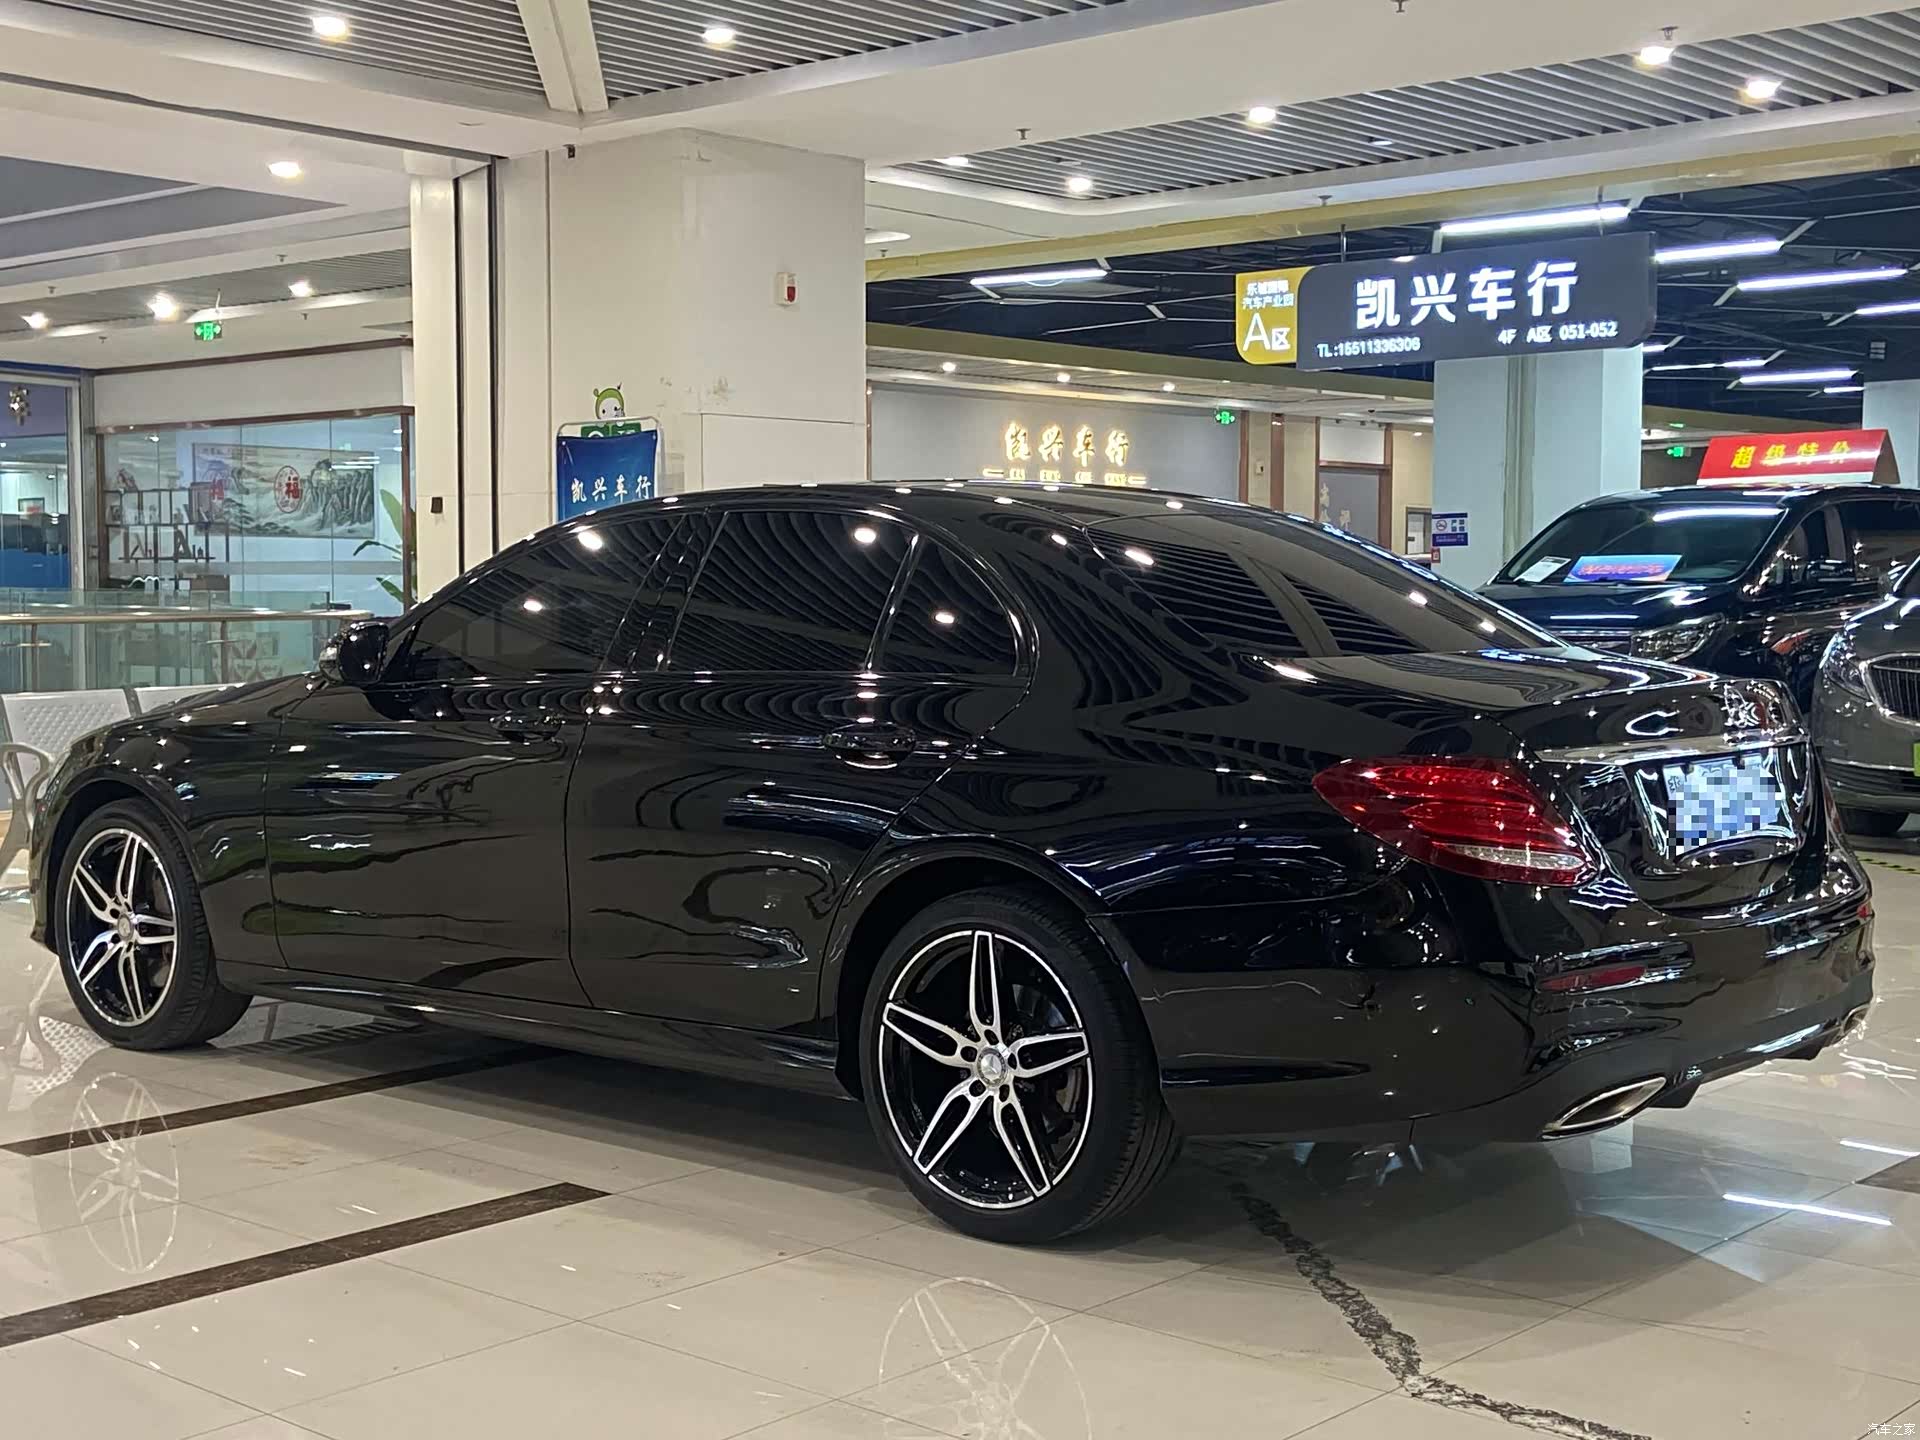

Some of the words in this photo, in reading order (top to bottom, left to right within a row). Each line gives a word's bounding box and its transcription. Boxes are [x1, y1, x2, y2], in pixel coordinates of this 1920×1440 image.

[1356, 261, 1578, 330] 凯兴车行
[1242, 312, 1291, 351] A区
[1498, 329, 1517, 345] 4F
[1526, 325, 1553, 343] A区
[1559, 320, 1619, 341] 051-052
[1730, 440, 1850, 469] 超级特价
